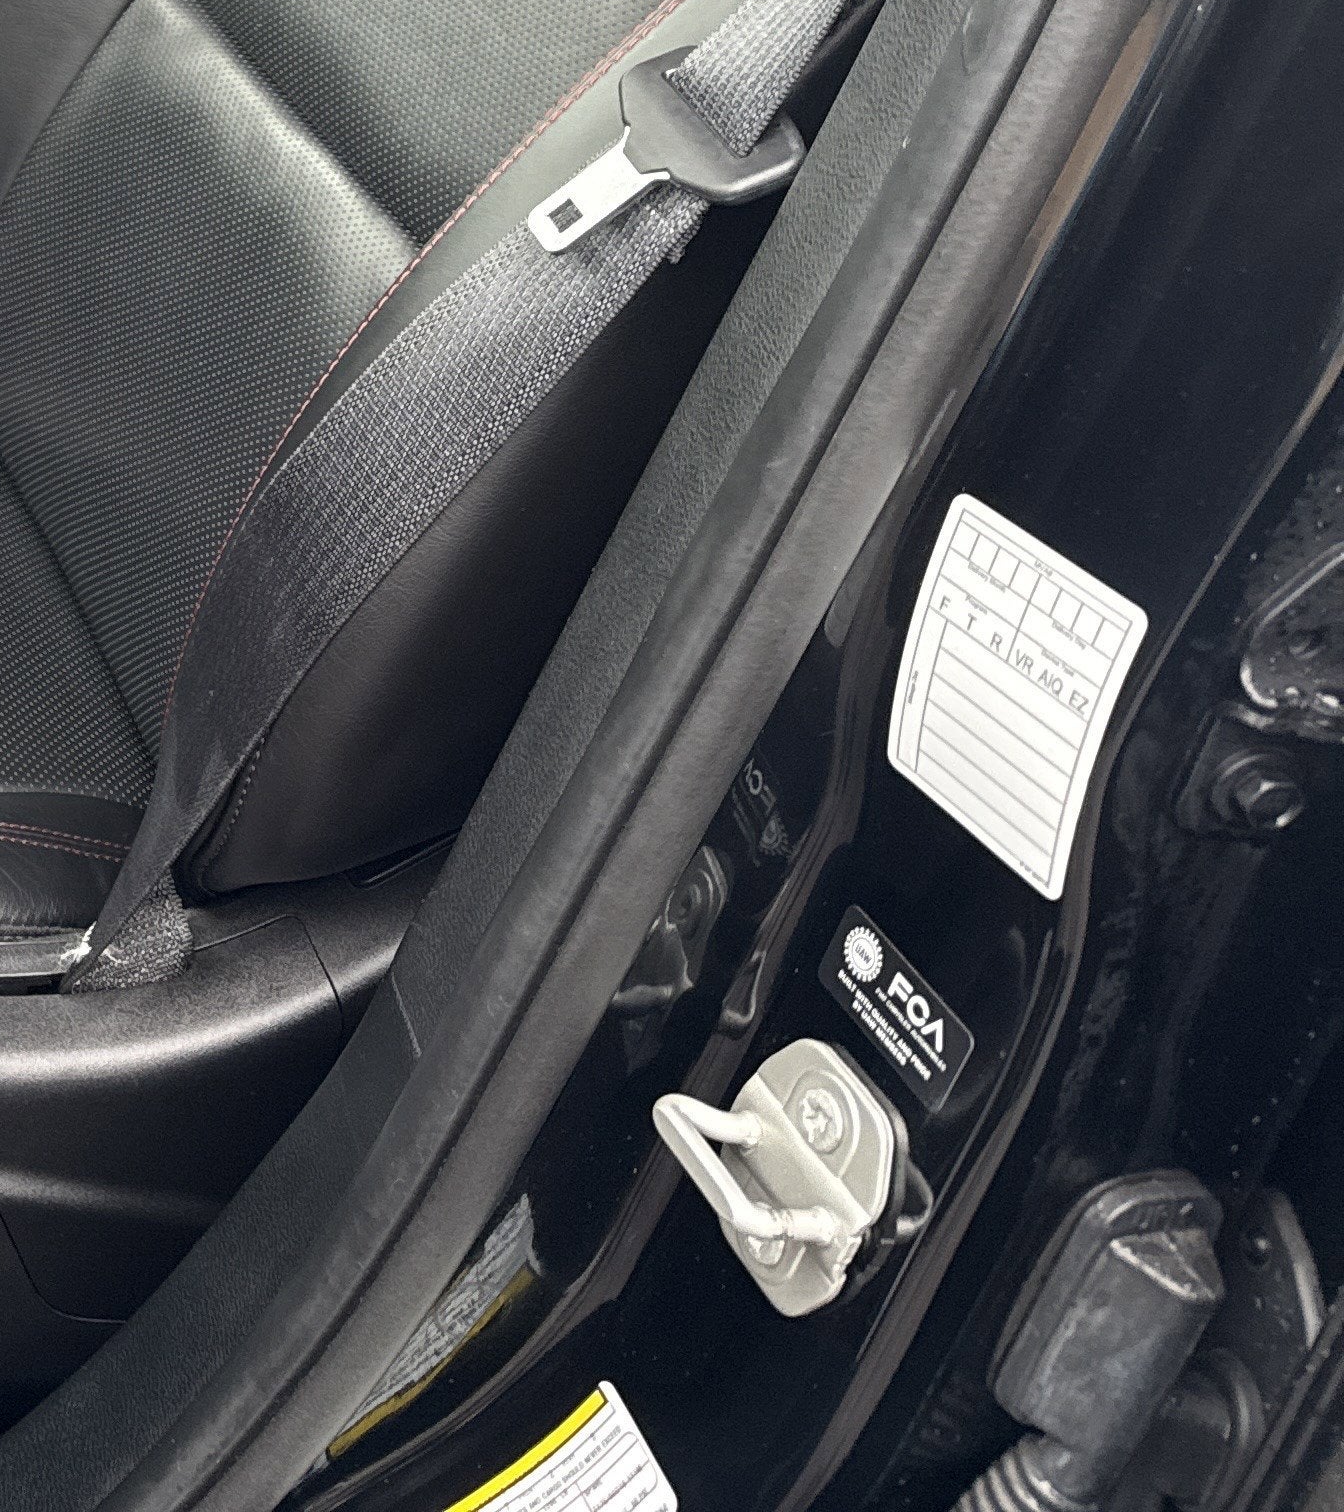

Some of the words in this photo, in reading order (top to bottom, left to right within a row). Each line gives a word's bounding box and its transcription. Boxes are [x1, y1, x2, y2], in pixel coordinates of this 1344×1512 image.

[940, 596, 951, 610] F
[967, 613, 977, 630] T
[990, 632, 1003, 652] R
[1016, 649, 1034, 675] VR
[1069, 690, 1089, 715] EZ
[888, 971, 943, 1053] FCA
